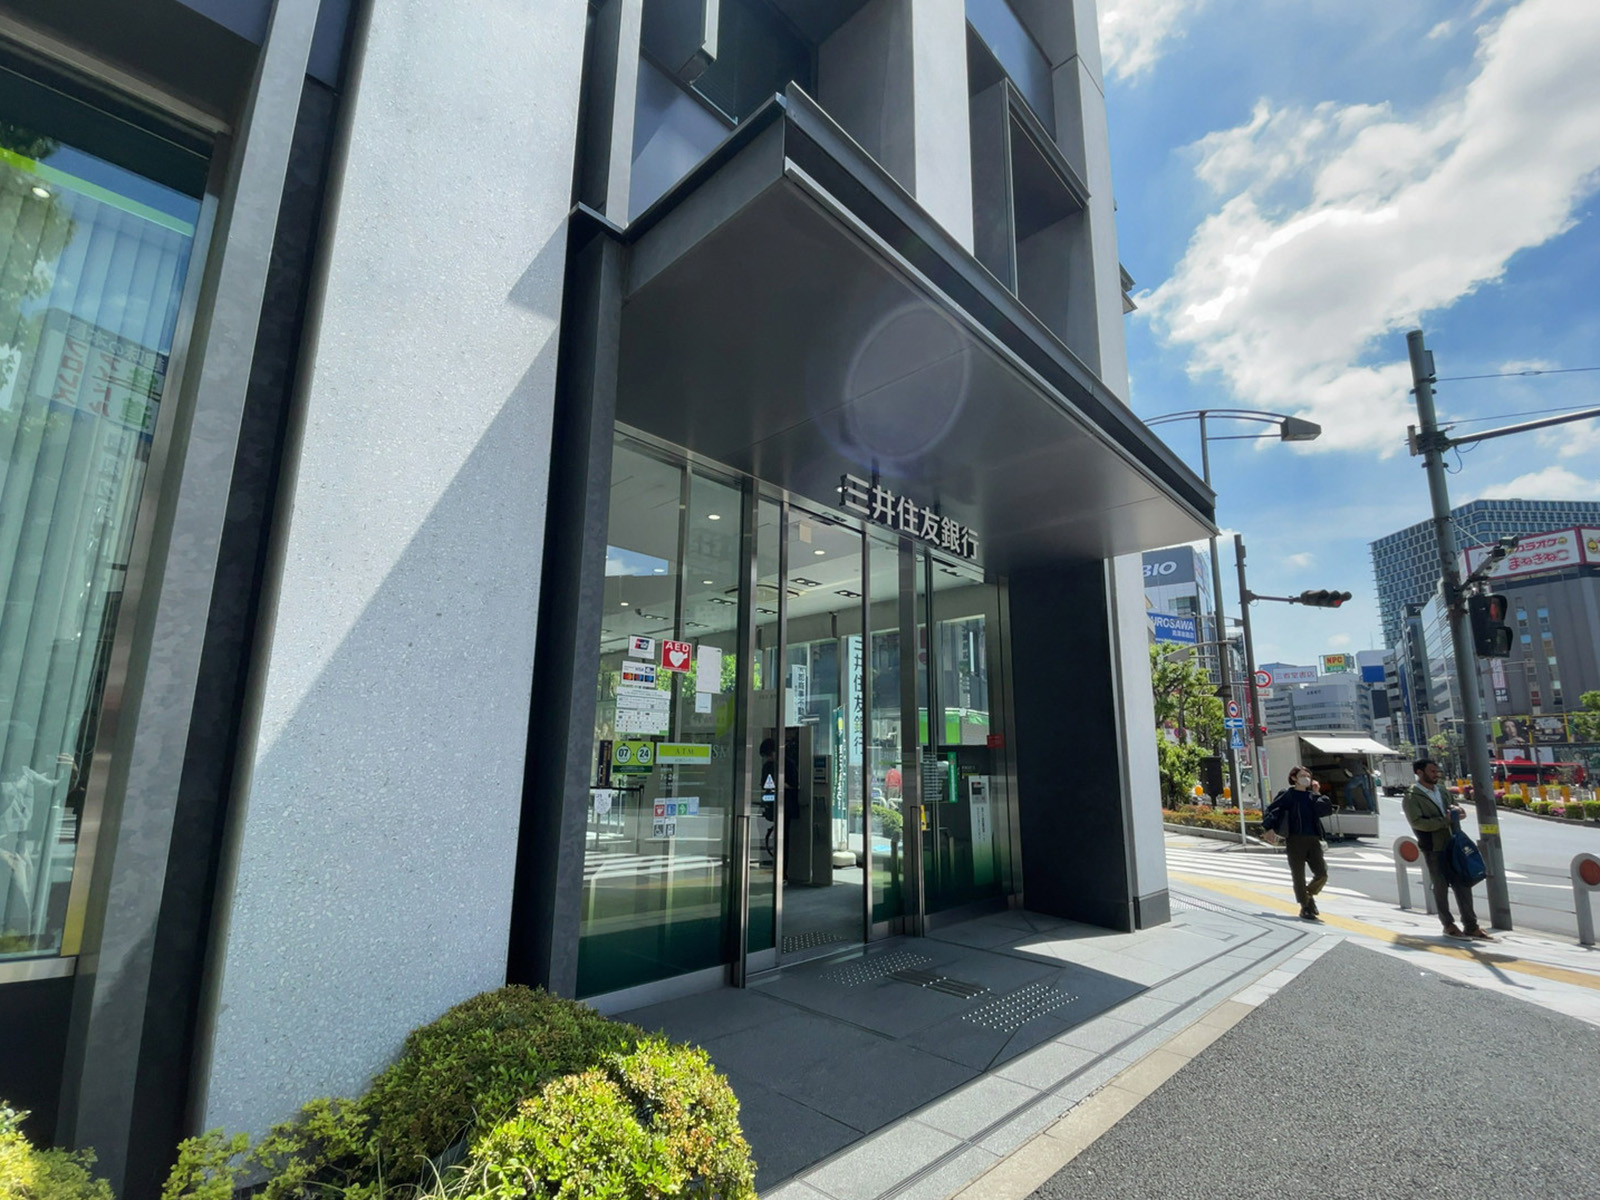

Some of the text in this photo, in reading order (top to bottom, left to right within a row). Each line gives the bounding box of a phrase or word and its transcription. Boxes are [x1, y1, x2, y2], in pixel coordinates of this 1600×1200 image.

[845, 473, 979, 560] 三井住友銀行
[1509, 549, 1570, 570] まねきねこ
[665, 641, 689, 652] AED
[1326, 656, 1343, 664] NPC
[618, 748, 649, 758] 07 24
